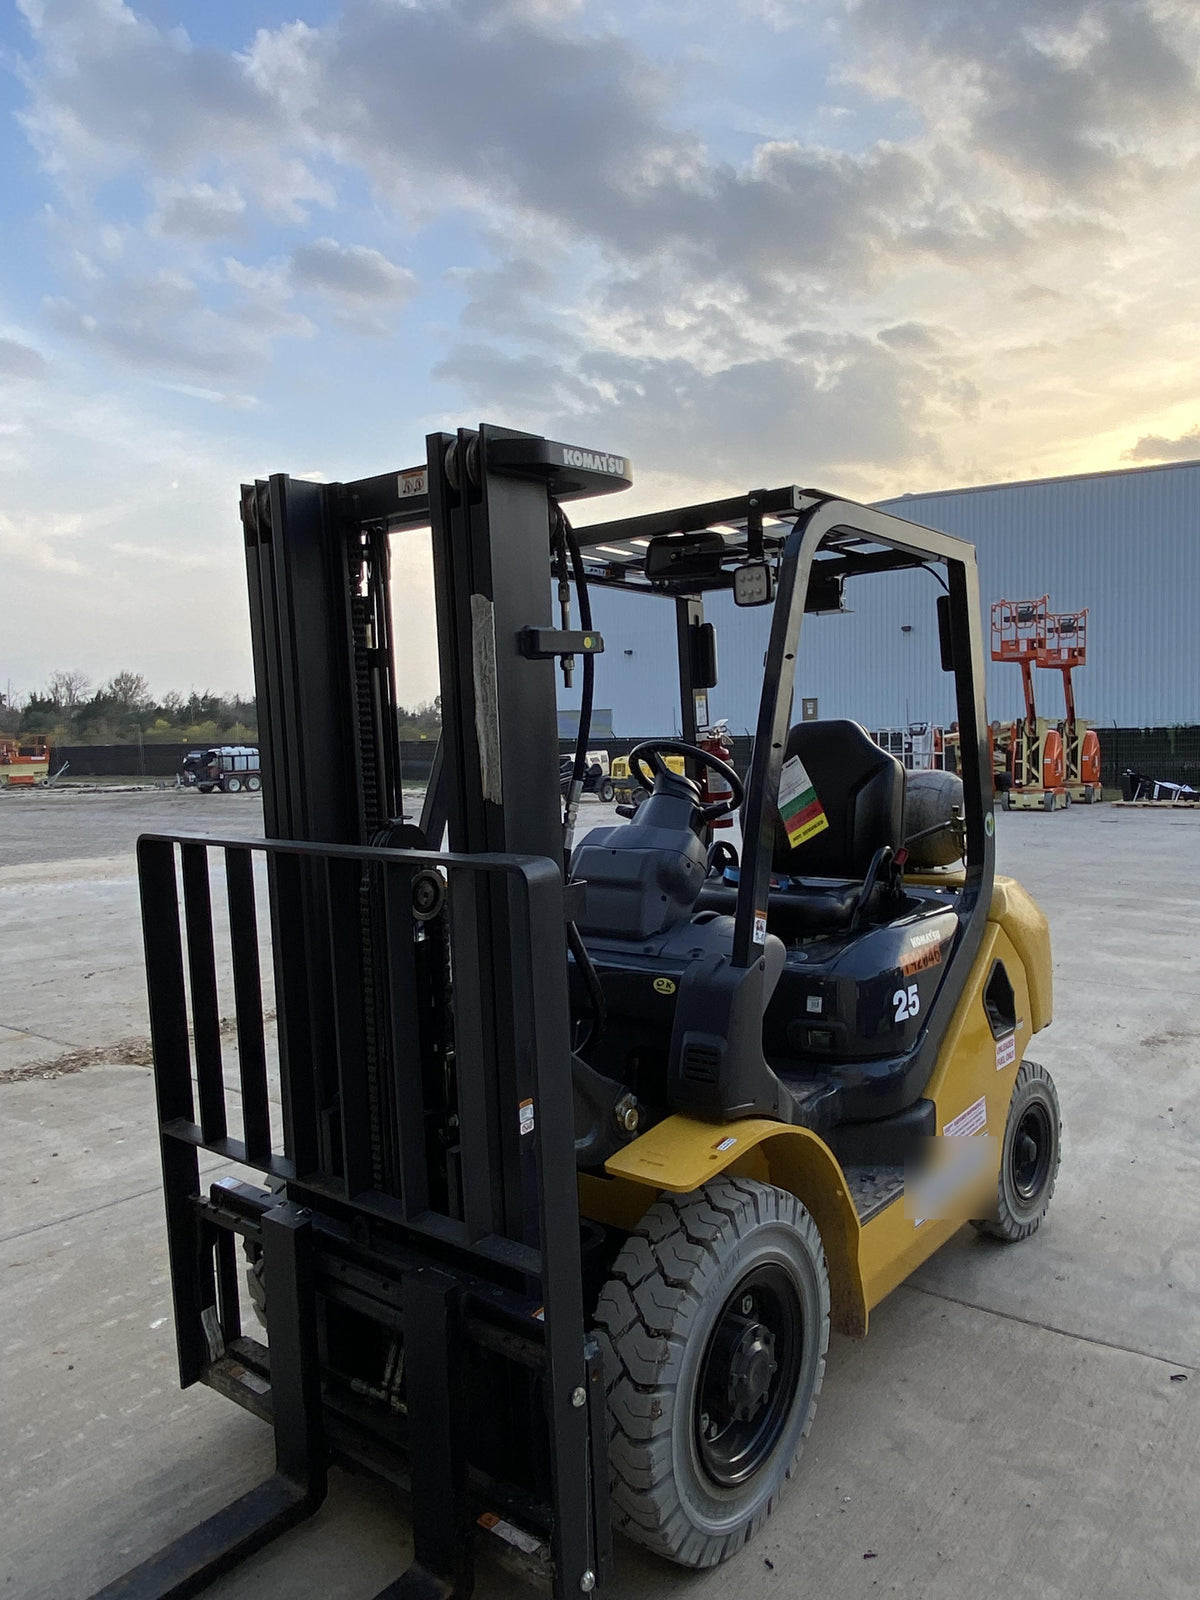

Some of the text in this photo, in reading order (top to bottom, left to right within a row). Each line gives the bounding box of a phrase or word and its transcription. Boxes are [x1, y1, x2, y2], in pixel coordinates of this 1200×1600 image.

[563, 449, 624, 475] KOMATSU
[910, 930, 940, 948] KOMATSU
[656, 979, 673, 989] OK
[892, 984, 920, 1023] 25
